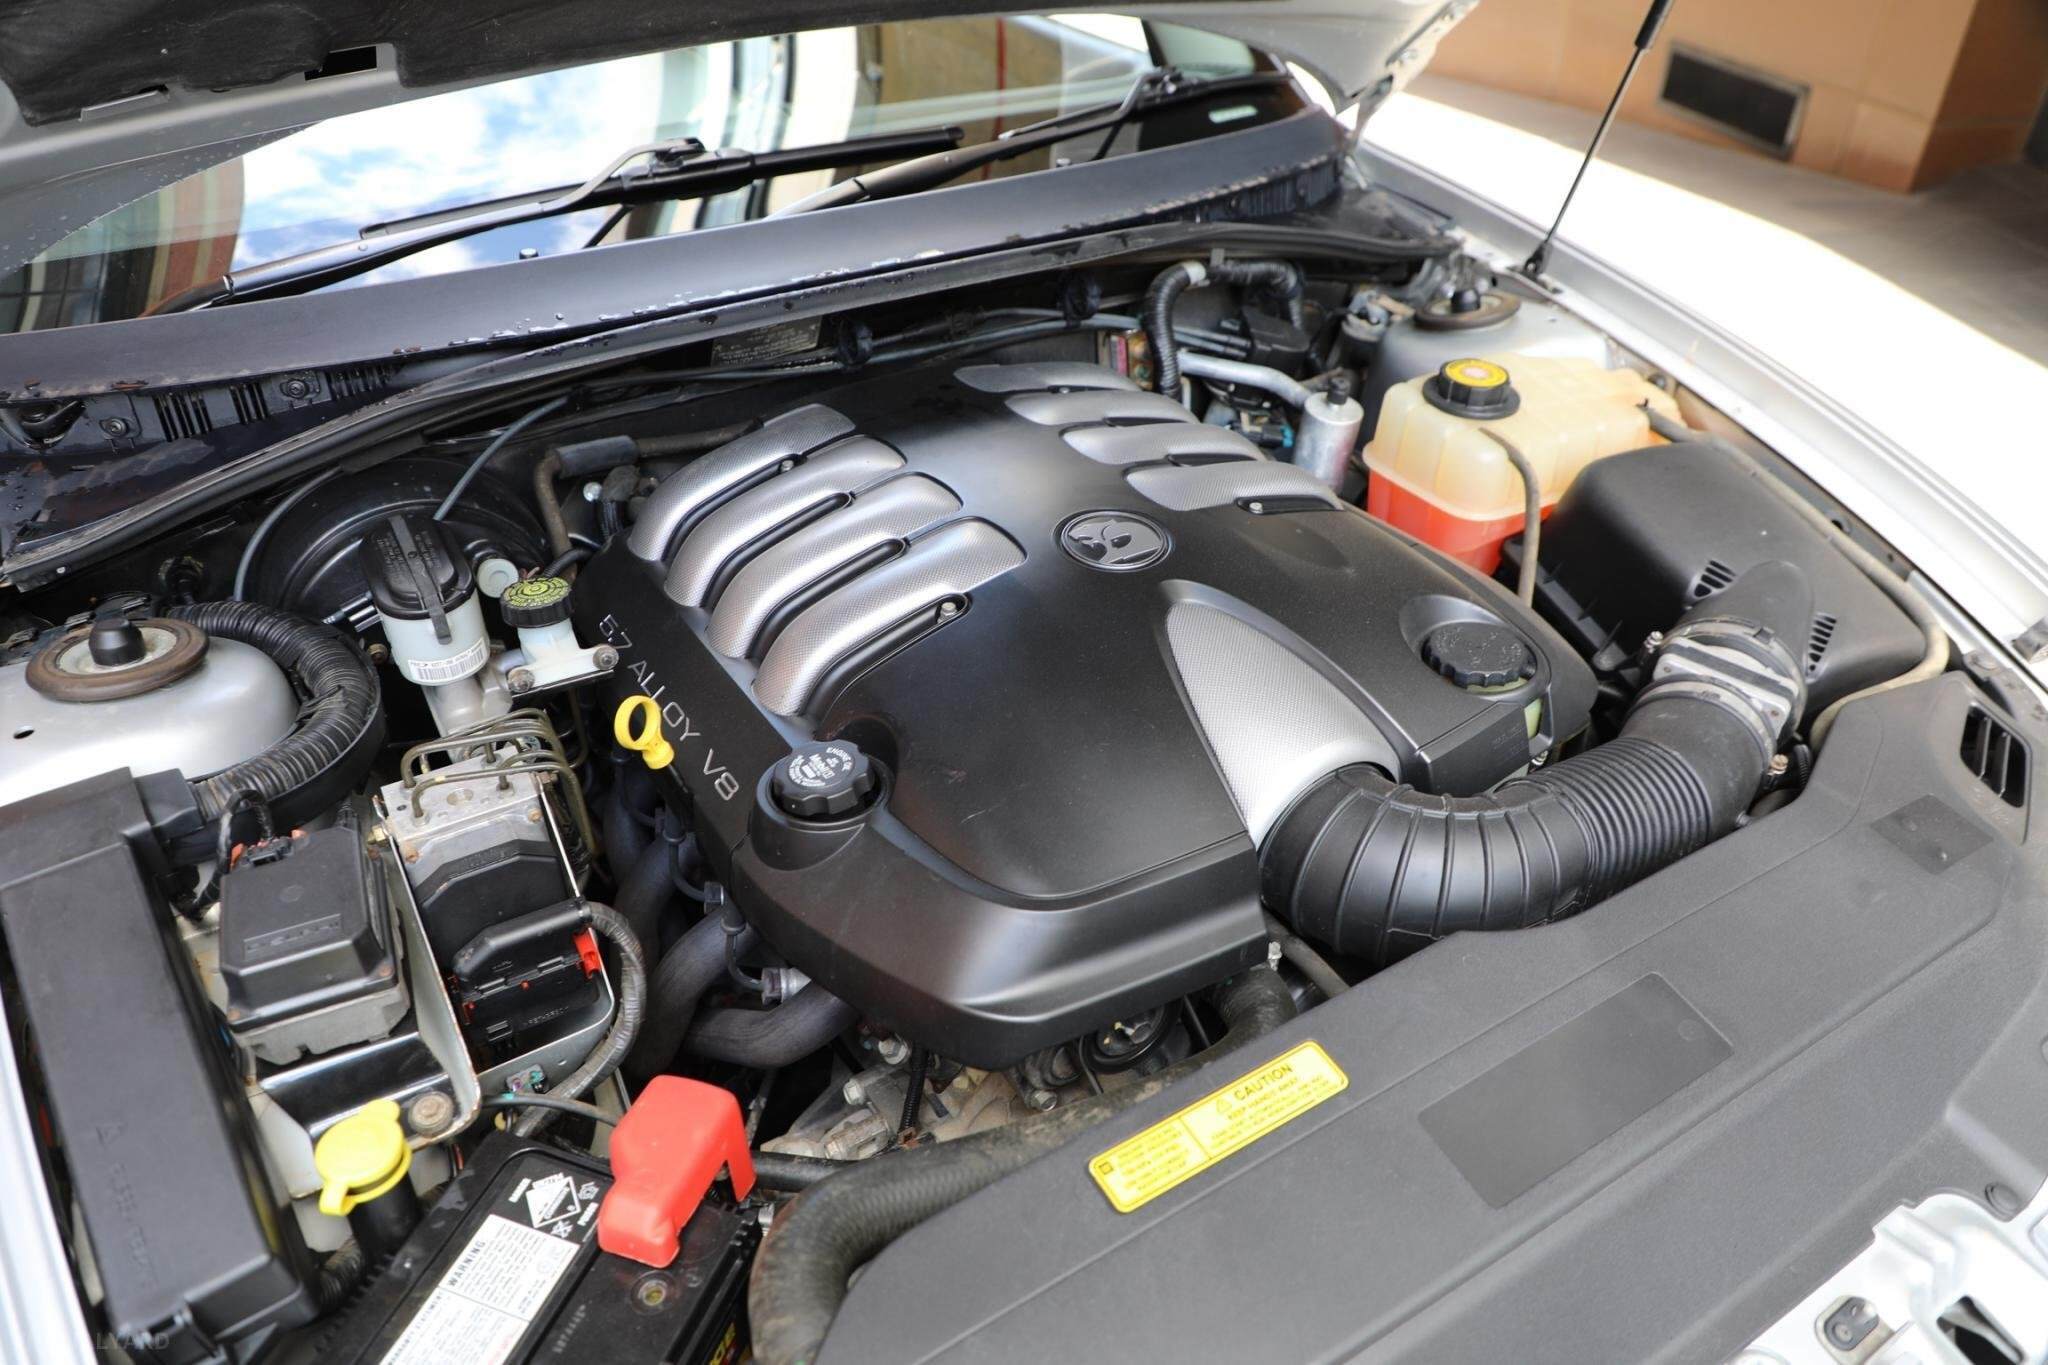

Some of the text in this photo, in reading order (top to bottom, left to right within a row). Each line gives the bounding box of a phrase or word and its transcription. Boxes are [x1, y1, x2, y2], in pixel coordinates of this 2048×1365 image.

[600, 614, 633, 650] 5.7
[703, 748, 740, 801] V8
[1233, 1064, 1294, 1102] CAUTION
[447, 1241, 486, 1287] WARNING
